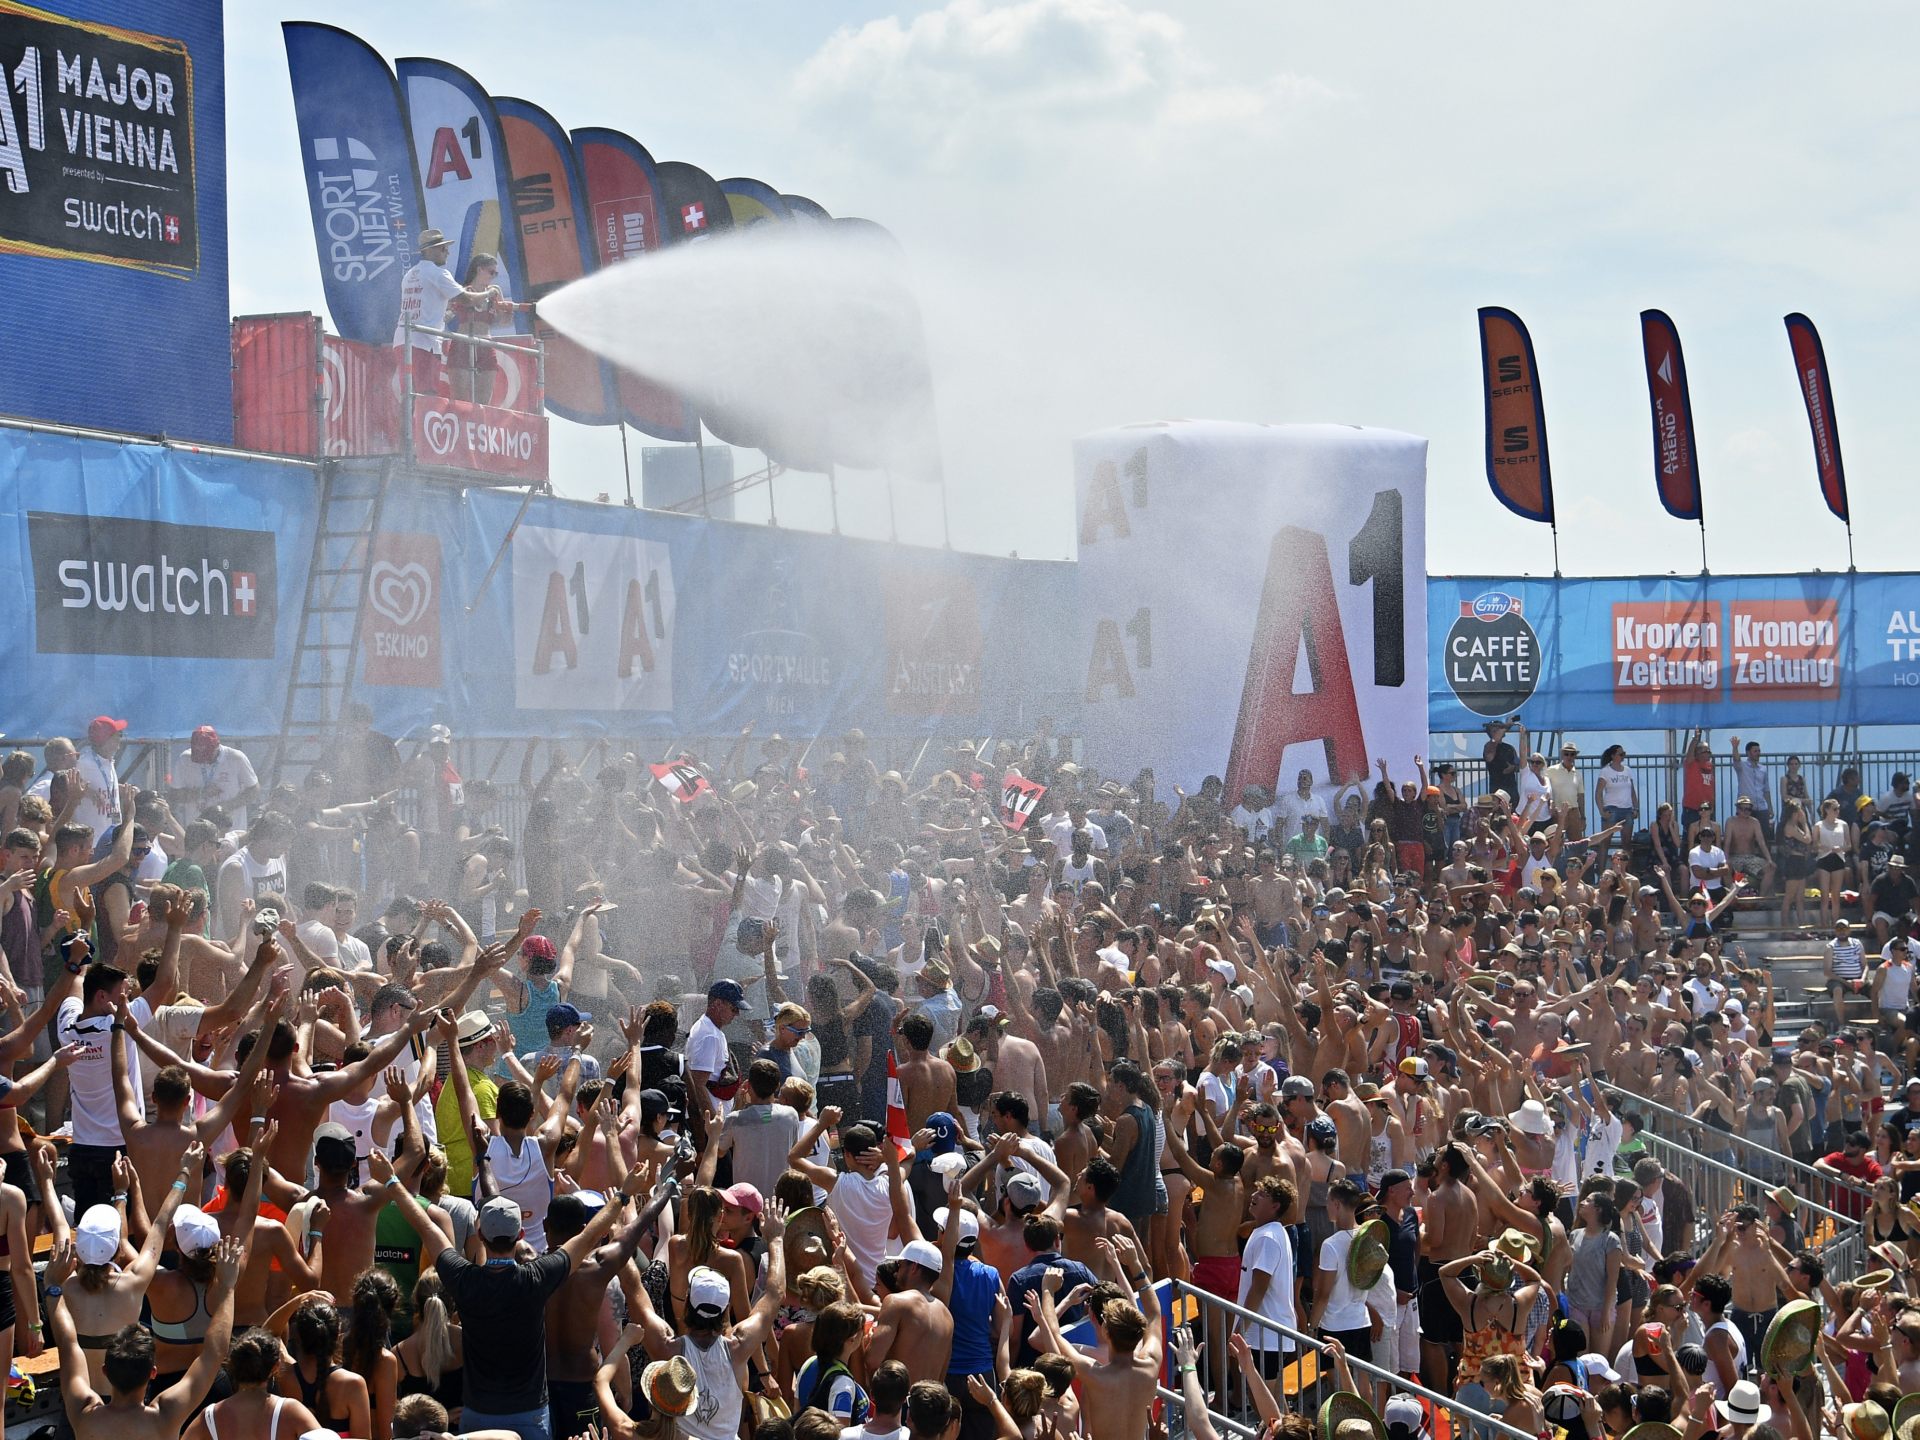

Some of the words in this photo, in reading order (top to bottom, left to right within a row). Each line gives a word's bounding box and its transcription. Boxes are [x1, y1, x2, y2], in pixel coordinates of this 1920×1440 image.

[57, 49, 175, 116] MAJOR
[60, 108, 178, 174] VIENNA
[426, 116, 482, 189] A1
[62, 166, 95, 179] presented
[96, 170, 104, 184] by
[64, 197, 163, 241] swatch
[318, 171, 367, 281] SPORT
[523, 217, 572, 235] EAT
[606, 212, 619, 254] leben.
[1492, 384, 1531, 398] SEAT
[466, 421, 533, 461] ESKIMO
[1494, 455, 1538, 465] SEAT
[1665, 413, 1679, 474] TREND
[1081, 446, 1148, 545] A1
[58, 555, 230, 616] swatch
[1475, 599, 1508, 612] Emmi
[532, 561, 589, 675] A1
[618, 569, 665, 679] A1
[1616, 616, 1718, 649] Kronen
[1734, 614, 1833, 648] Kronen
[375, 632, 429, 658] ESKIMO
[1086, 607, 1152, 703] A1
[1220, 488, 1405, 813] A1
[1452, 630, 1530, 658] CAFFÈ
[1453, 661, 1531, 682] LATTE
[1616, 653, 1719, 690] Zeitung
[1735, 651, 1834, 688] Zeitung
[375, 1250, 403, 1259] watch
